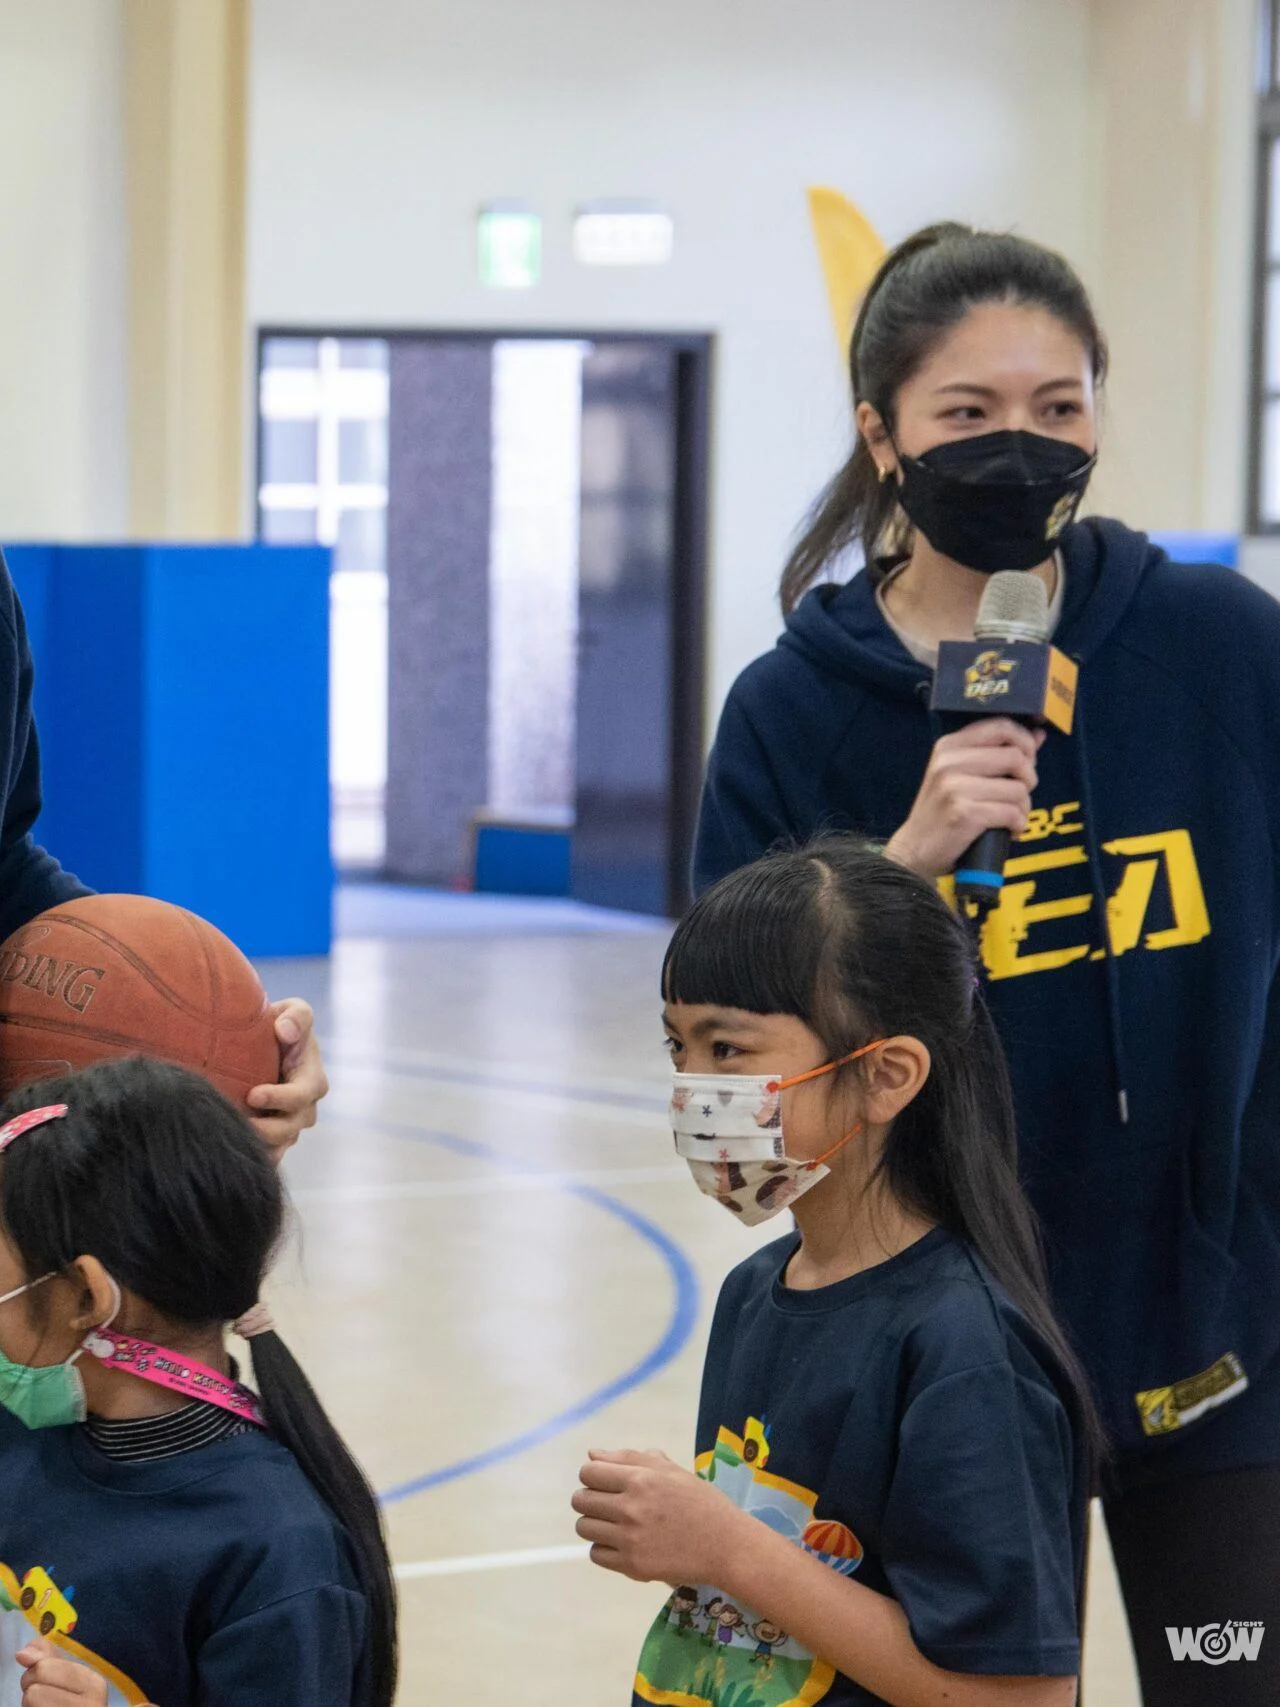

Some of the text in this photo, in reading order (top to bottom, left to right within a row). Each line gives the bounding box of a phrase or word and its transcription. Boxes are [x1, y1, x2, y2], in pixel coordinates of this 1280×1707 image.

[964, 679, 1009, 697] DEA
[1019, 802, 1084, 842] BC
[937, 829, 1211, 980] EA
